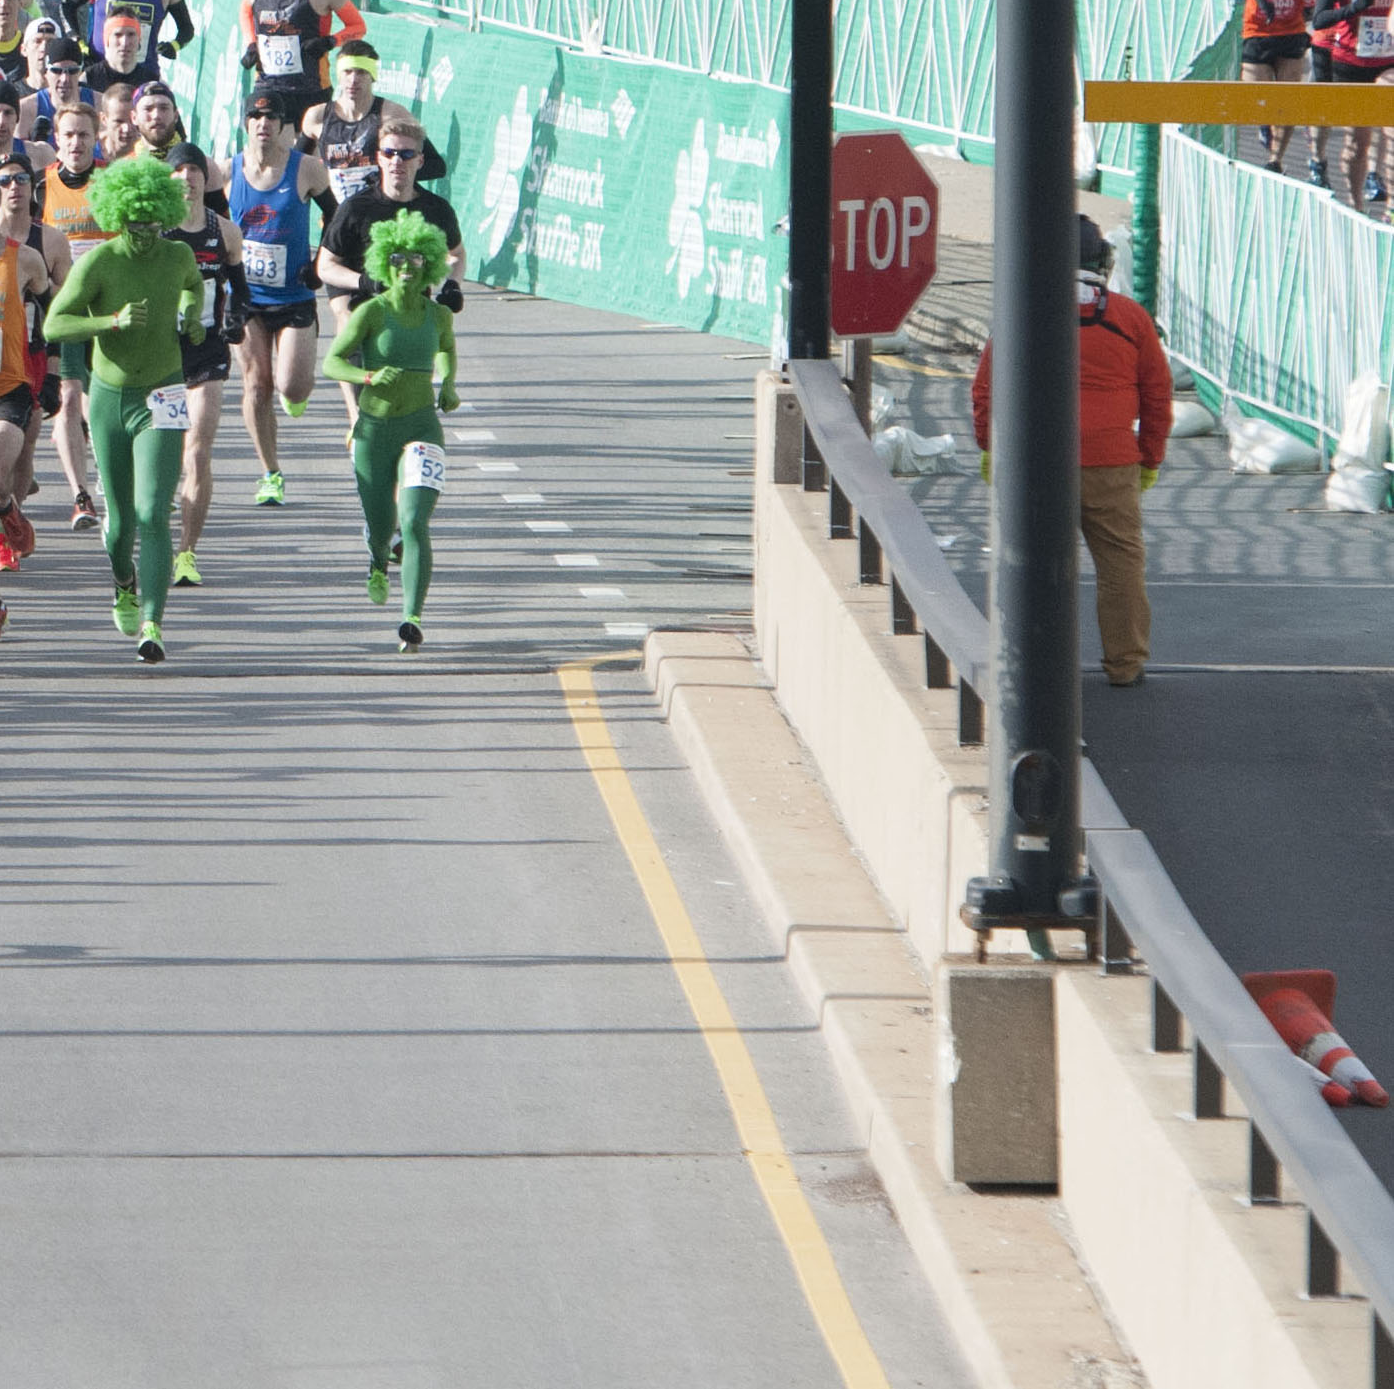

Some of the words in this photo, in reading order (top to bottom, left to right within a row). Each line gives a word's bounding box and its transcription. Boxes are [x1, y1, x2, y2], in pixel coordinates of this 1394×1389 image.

[266, 49, 295, 67] 182
[839, 195, 931, 272] TOP
[420, 459, 444, 480] 52
